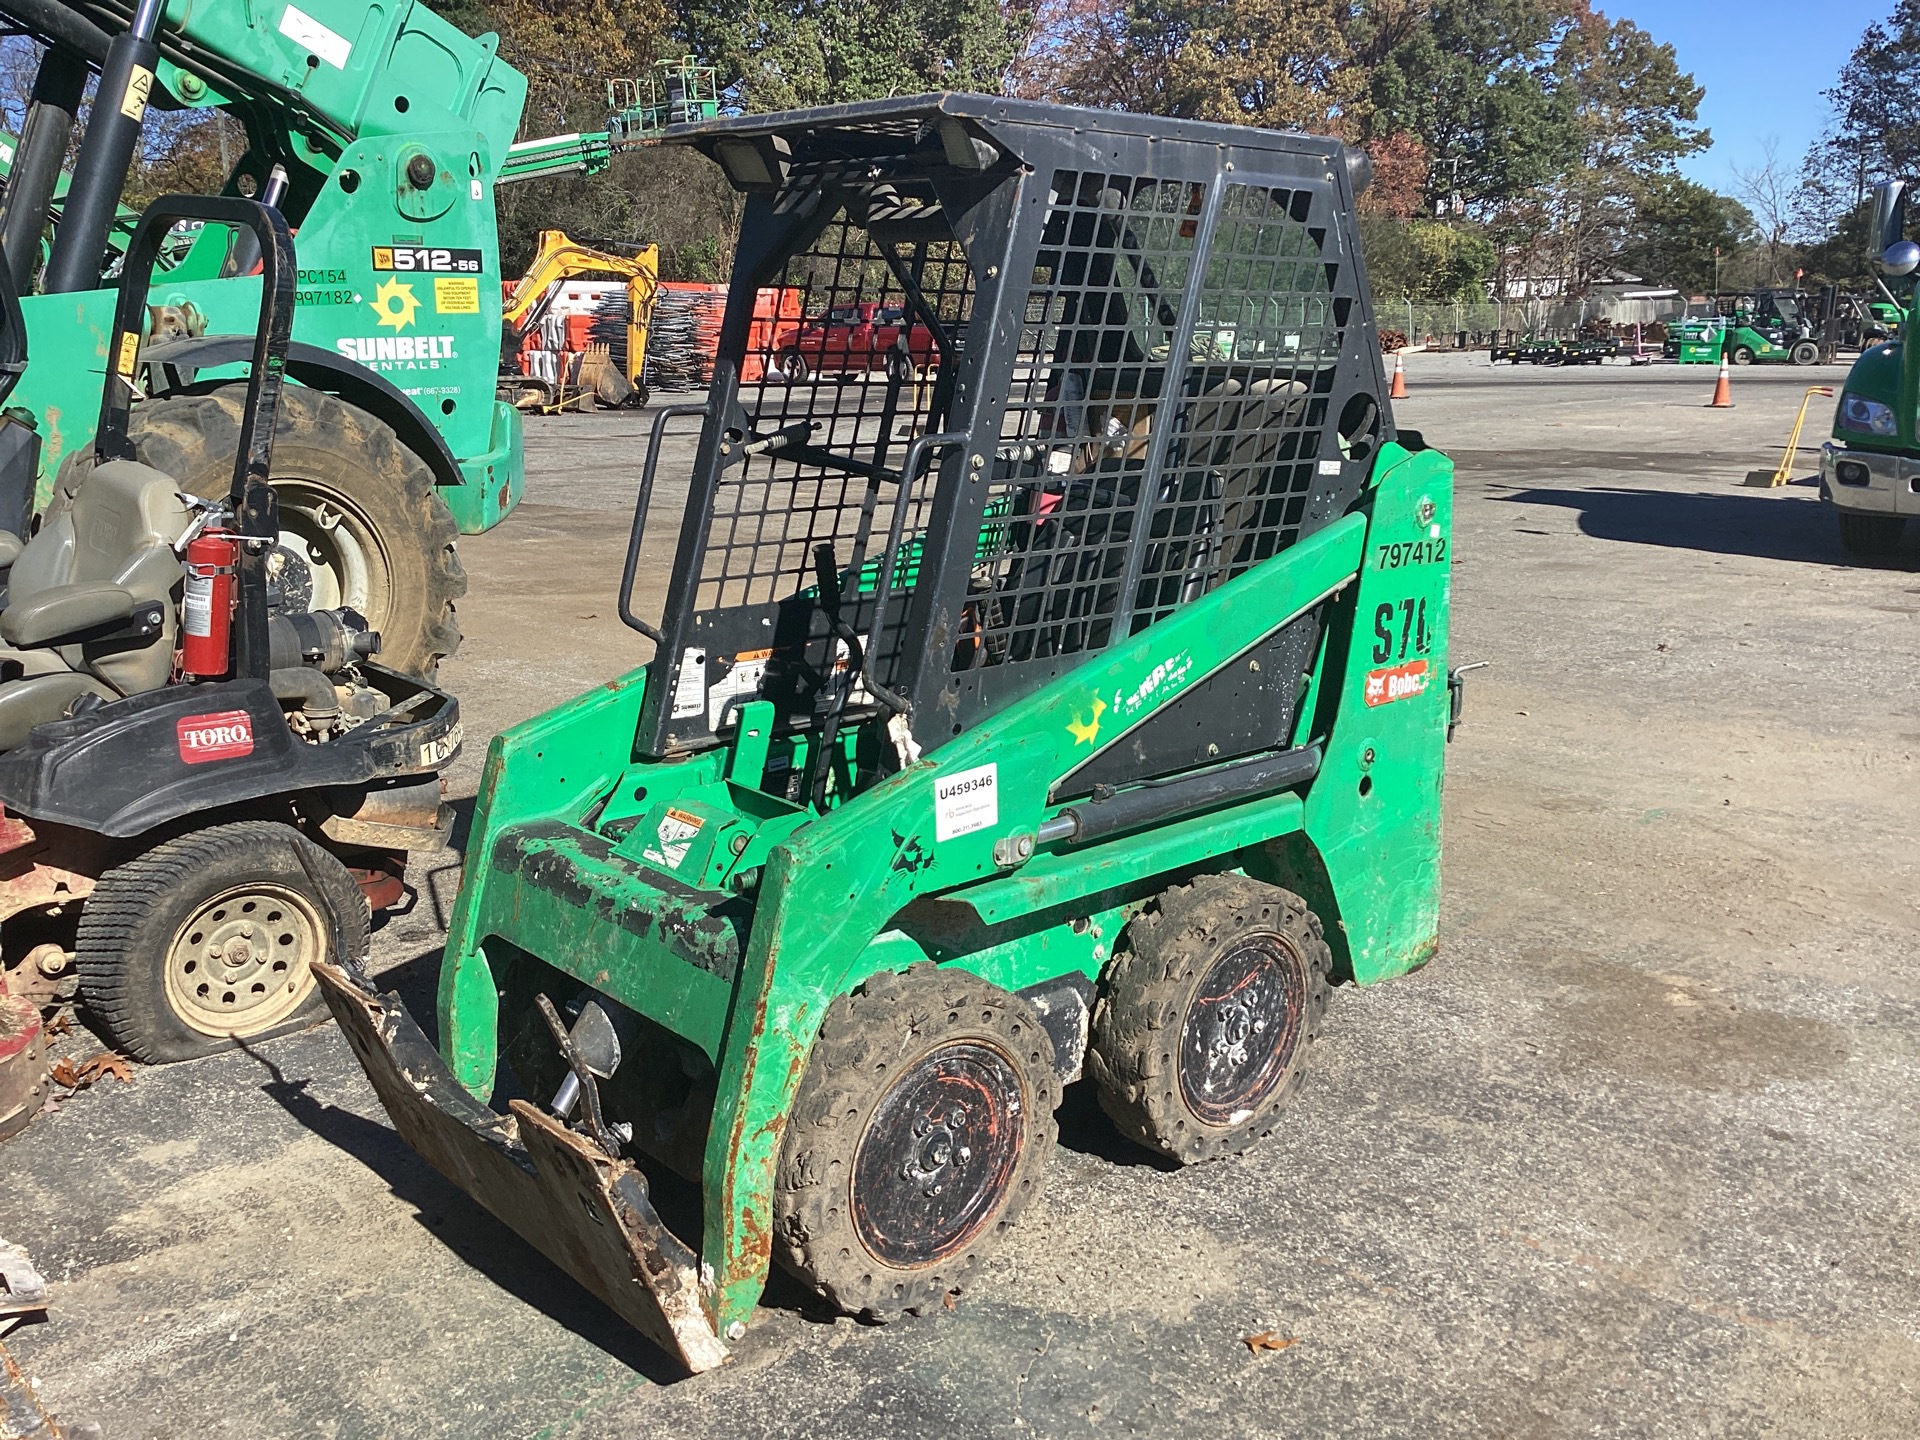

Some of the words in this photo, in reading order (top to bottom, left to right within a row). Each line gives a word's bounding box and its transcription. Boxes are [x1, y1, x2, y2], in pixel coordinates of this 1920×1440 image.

[337, 335, 455, 361] SUNBELT
[1379, 537, 1447, 570] 797412
[940, 774, 993, 800] U459346
